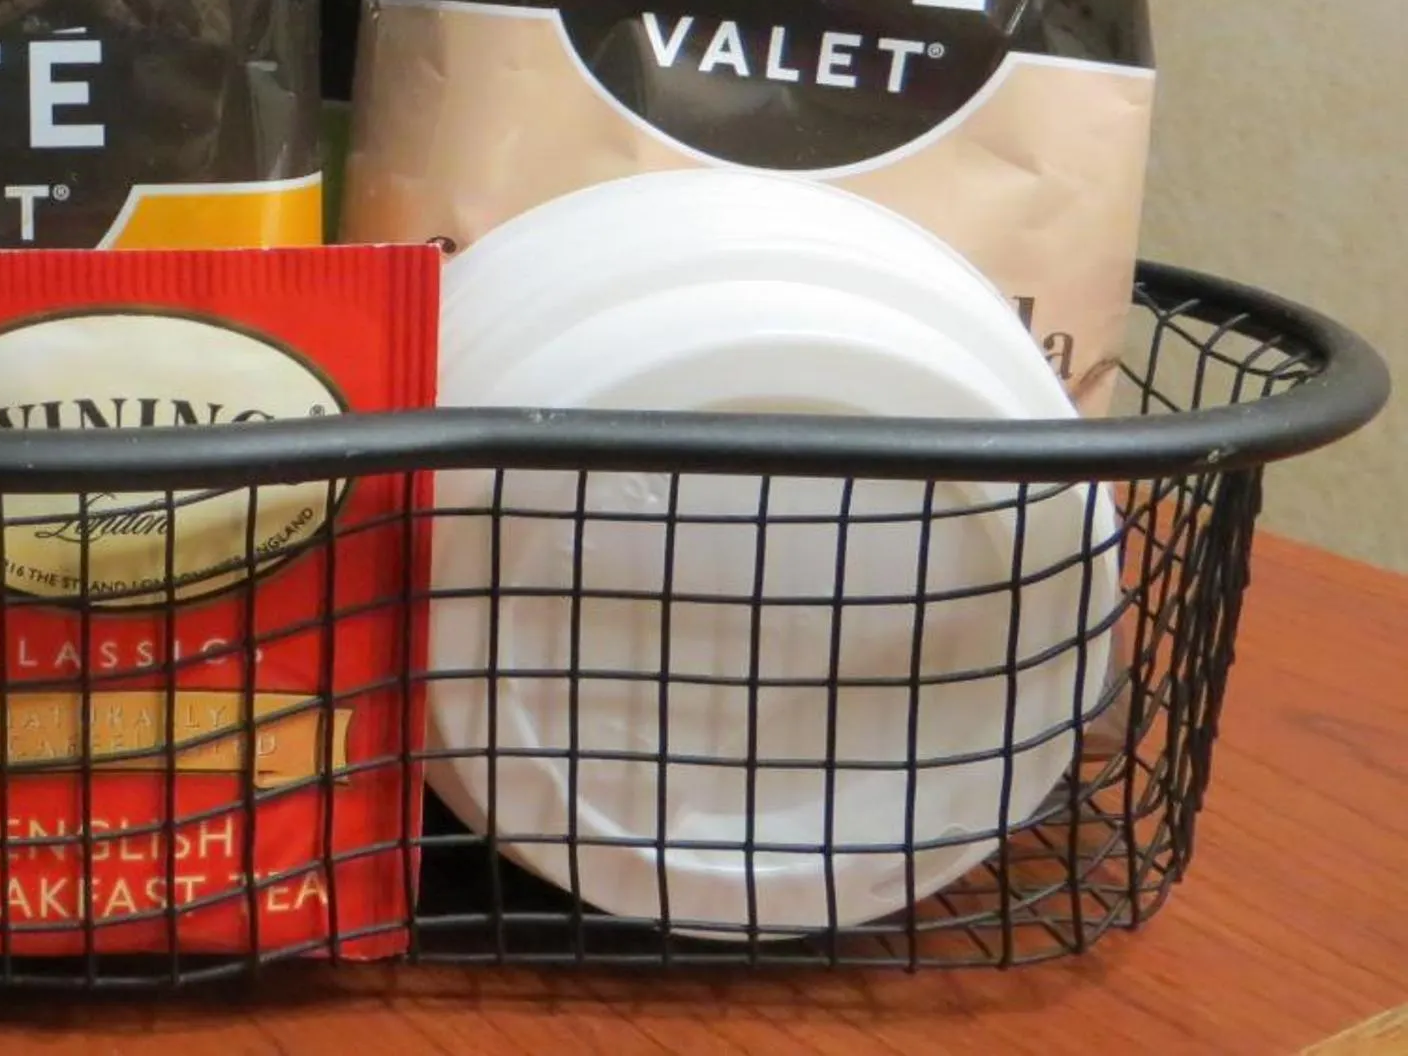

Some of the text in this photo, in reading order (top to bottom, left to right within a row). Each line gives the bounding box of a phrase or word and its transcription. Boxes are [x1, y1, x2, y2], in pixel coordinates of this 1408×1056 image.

[3, 559, 25, 578] 16
[29, 567, 59, 587] THE
[61, 576, 127, 593] STAND
[255, 506, 314, 554] NGLAND
